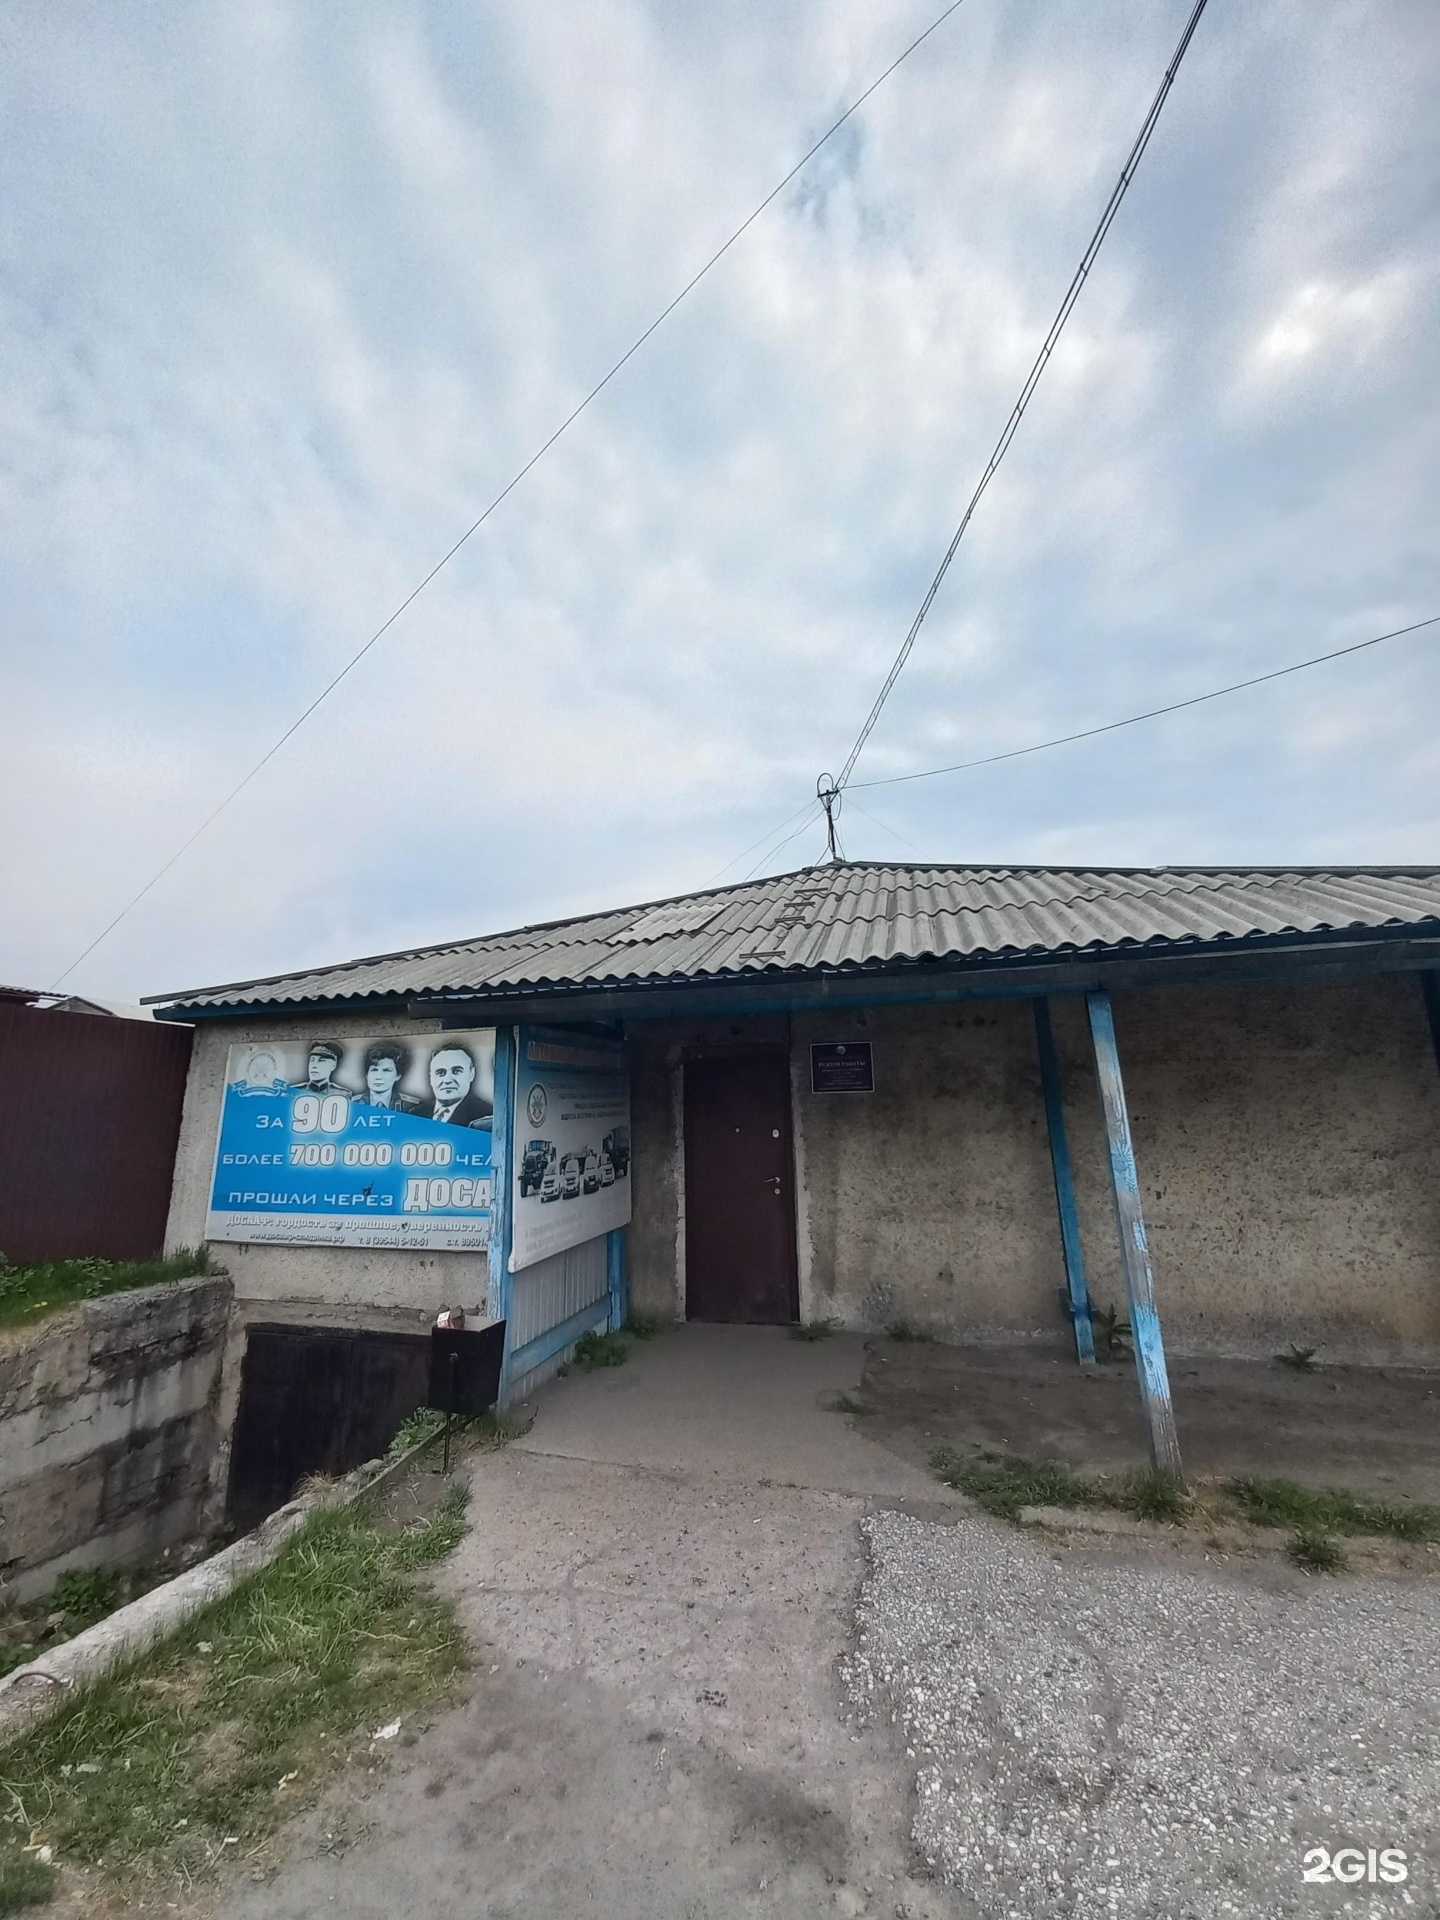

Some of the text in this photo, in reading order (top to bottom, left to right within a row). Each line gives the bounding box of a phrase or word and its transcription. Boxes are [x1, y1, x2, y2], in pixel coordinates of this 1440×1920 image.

[291, 1094, 350, 1134] 90
[222, 1153, 284, 1165] БОЛЕЕ
[290, 1143, 337, 1167] 700
[343, 1142, 393, 1167] 000
[400, 1142, 453, 1167] 000
[228, 1191, 317, 1205] ПРОШЛИ
[323, 1193, 394, 1206] ЧЕРЕЗ
